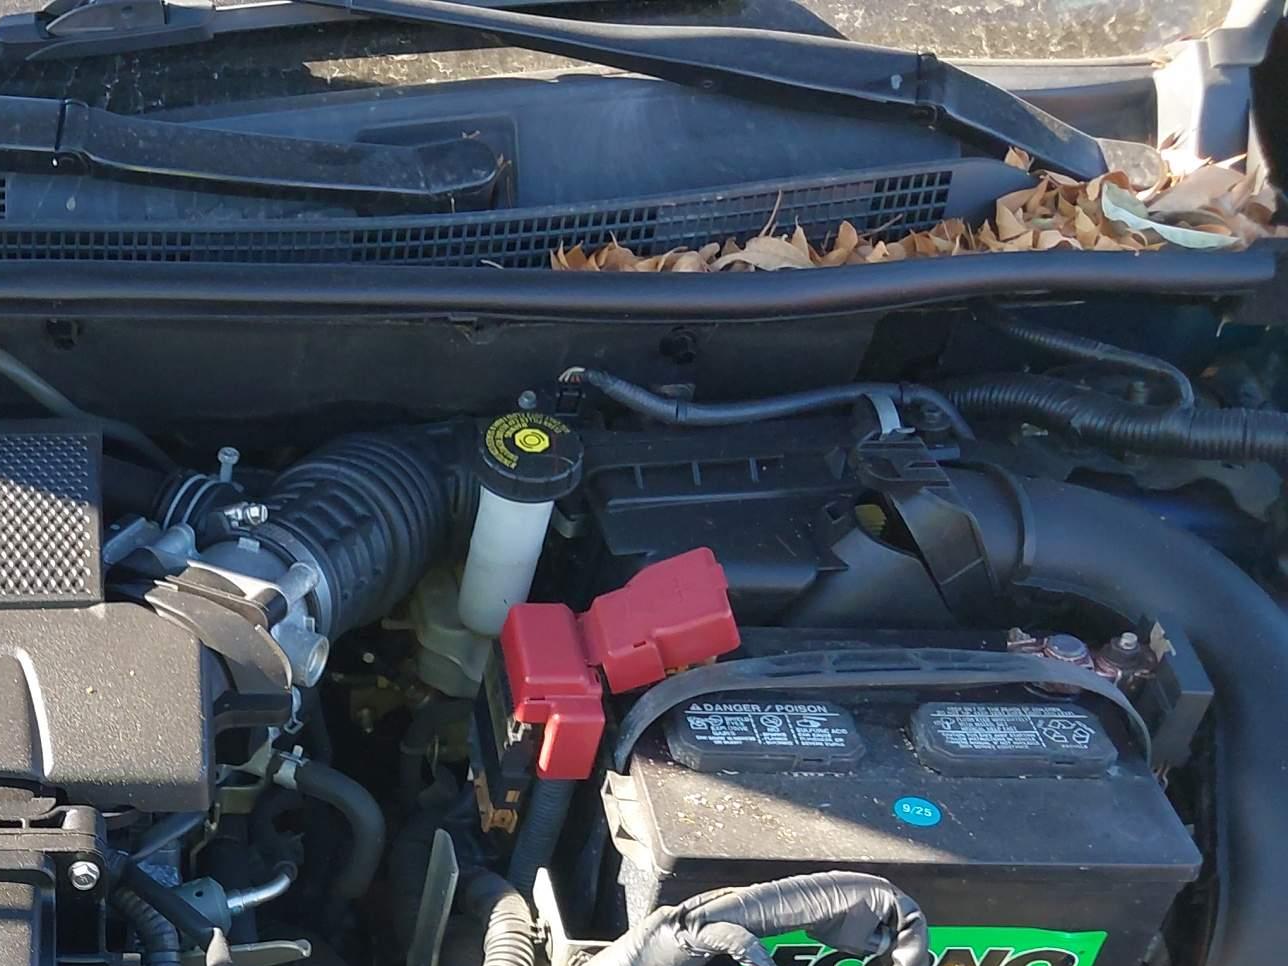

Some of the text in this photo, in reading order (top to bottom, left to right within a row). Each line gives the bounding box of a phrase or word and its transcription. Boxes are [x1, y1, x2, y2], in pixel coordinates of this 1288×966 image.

[704, 703, 762, 713] DANGER
[775, 704, 828, 714] POISON
[902, 803, 932, 817] 9/25
